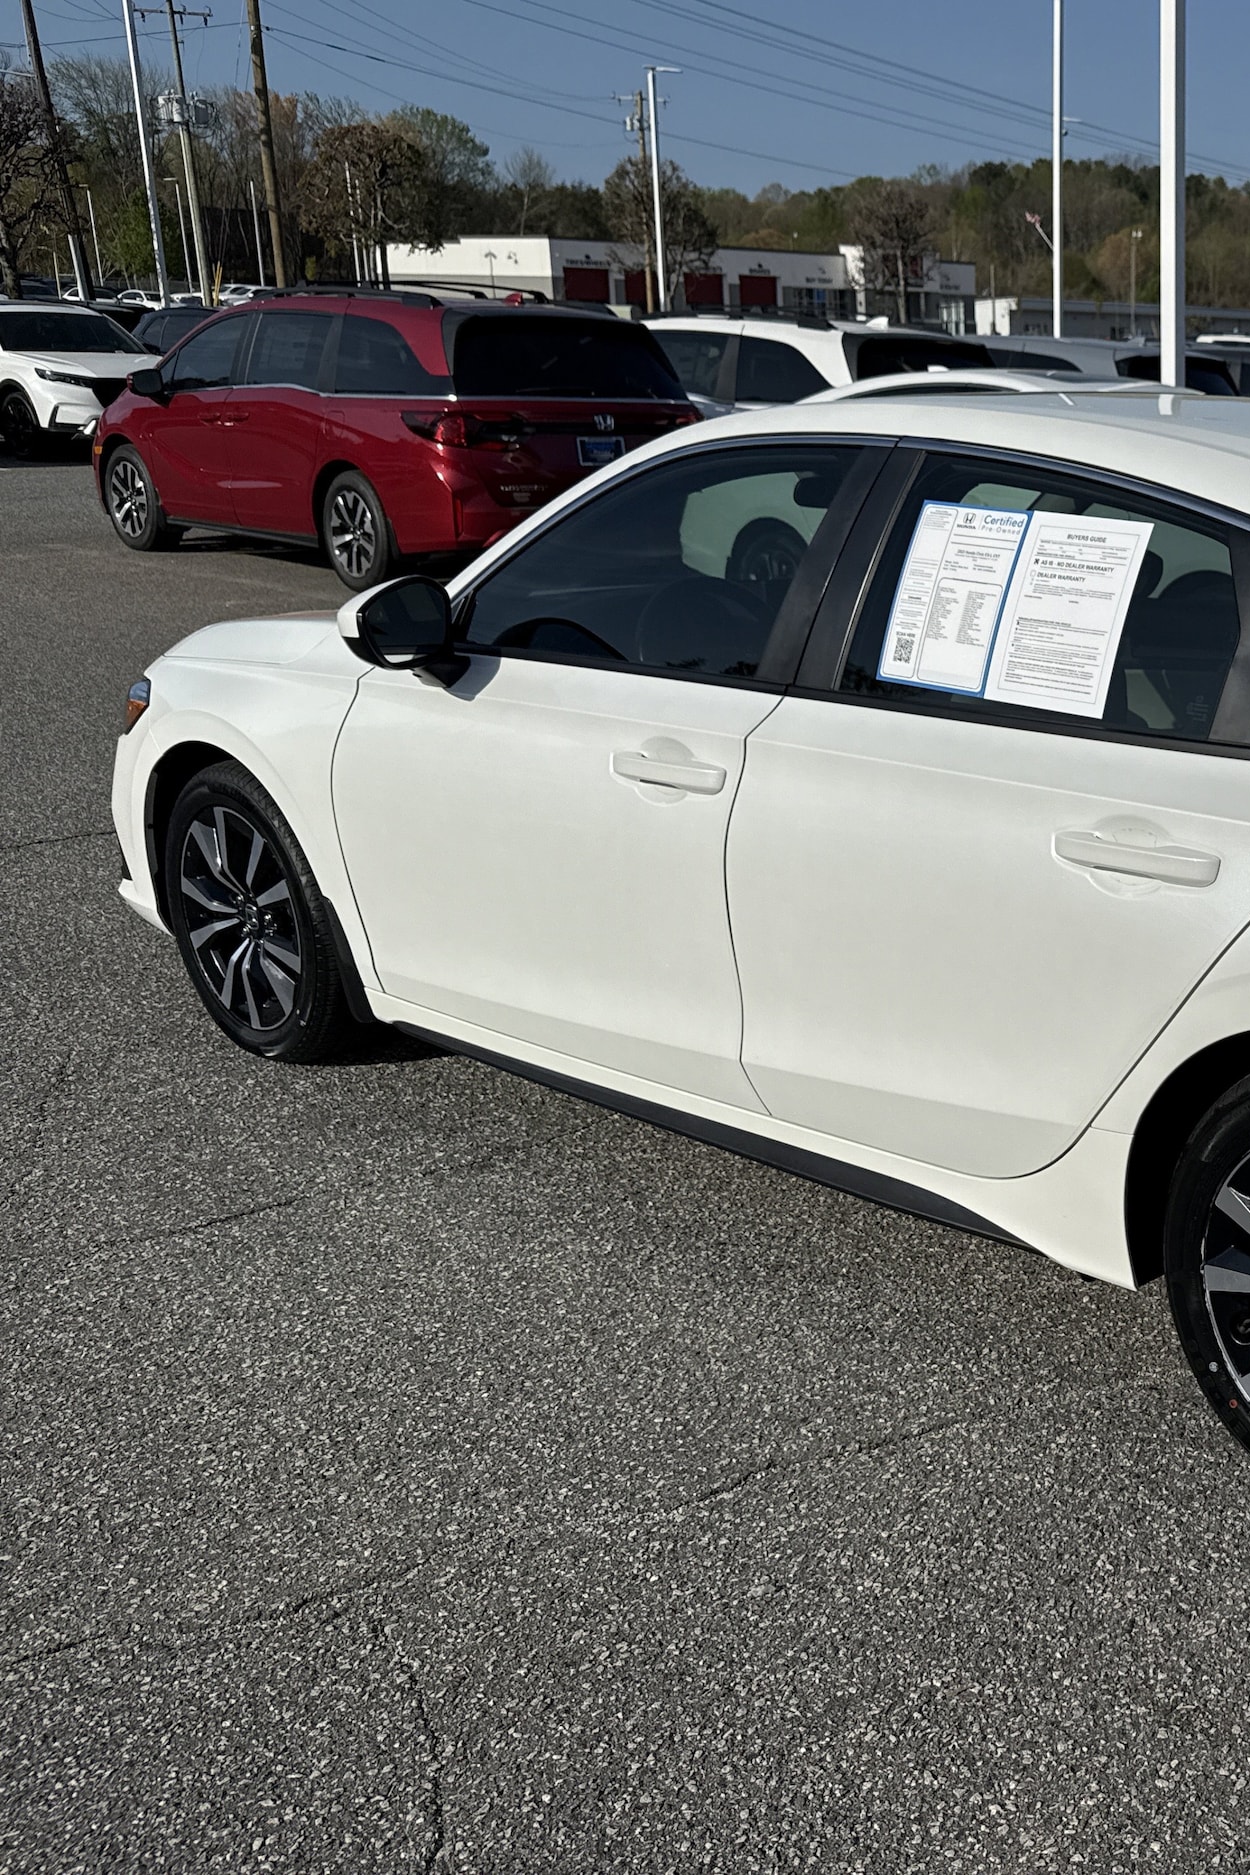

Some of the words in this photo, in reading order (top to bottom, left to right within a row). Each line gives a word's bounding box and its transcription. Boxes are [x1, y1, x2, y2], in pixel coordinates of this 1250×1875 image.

[983, 514, 1025, 529] Certified
[981, 525, 1022, 536] Pre-Owned
[1067, 533, 1089, 542] BUYERS
[1065, 562, 1085, 570] DEALER
[1085, 564, 1114, 573] WARRANTY
[1037, 571, 1057, 579] DEALER
[1057, 573, 1086, 583] WARRANTY
